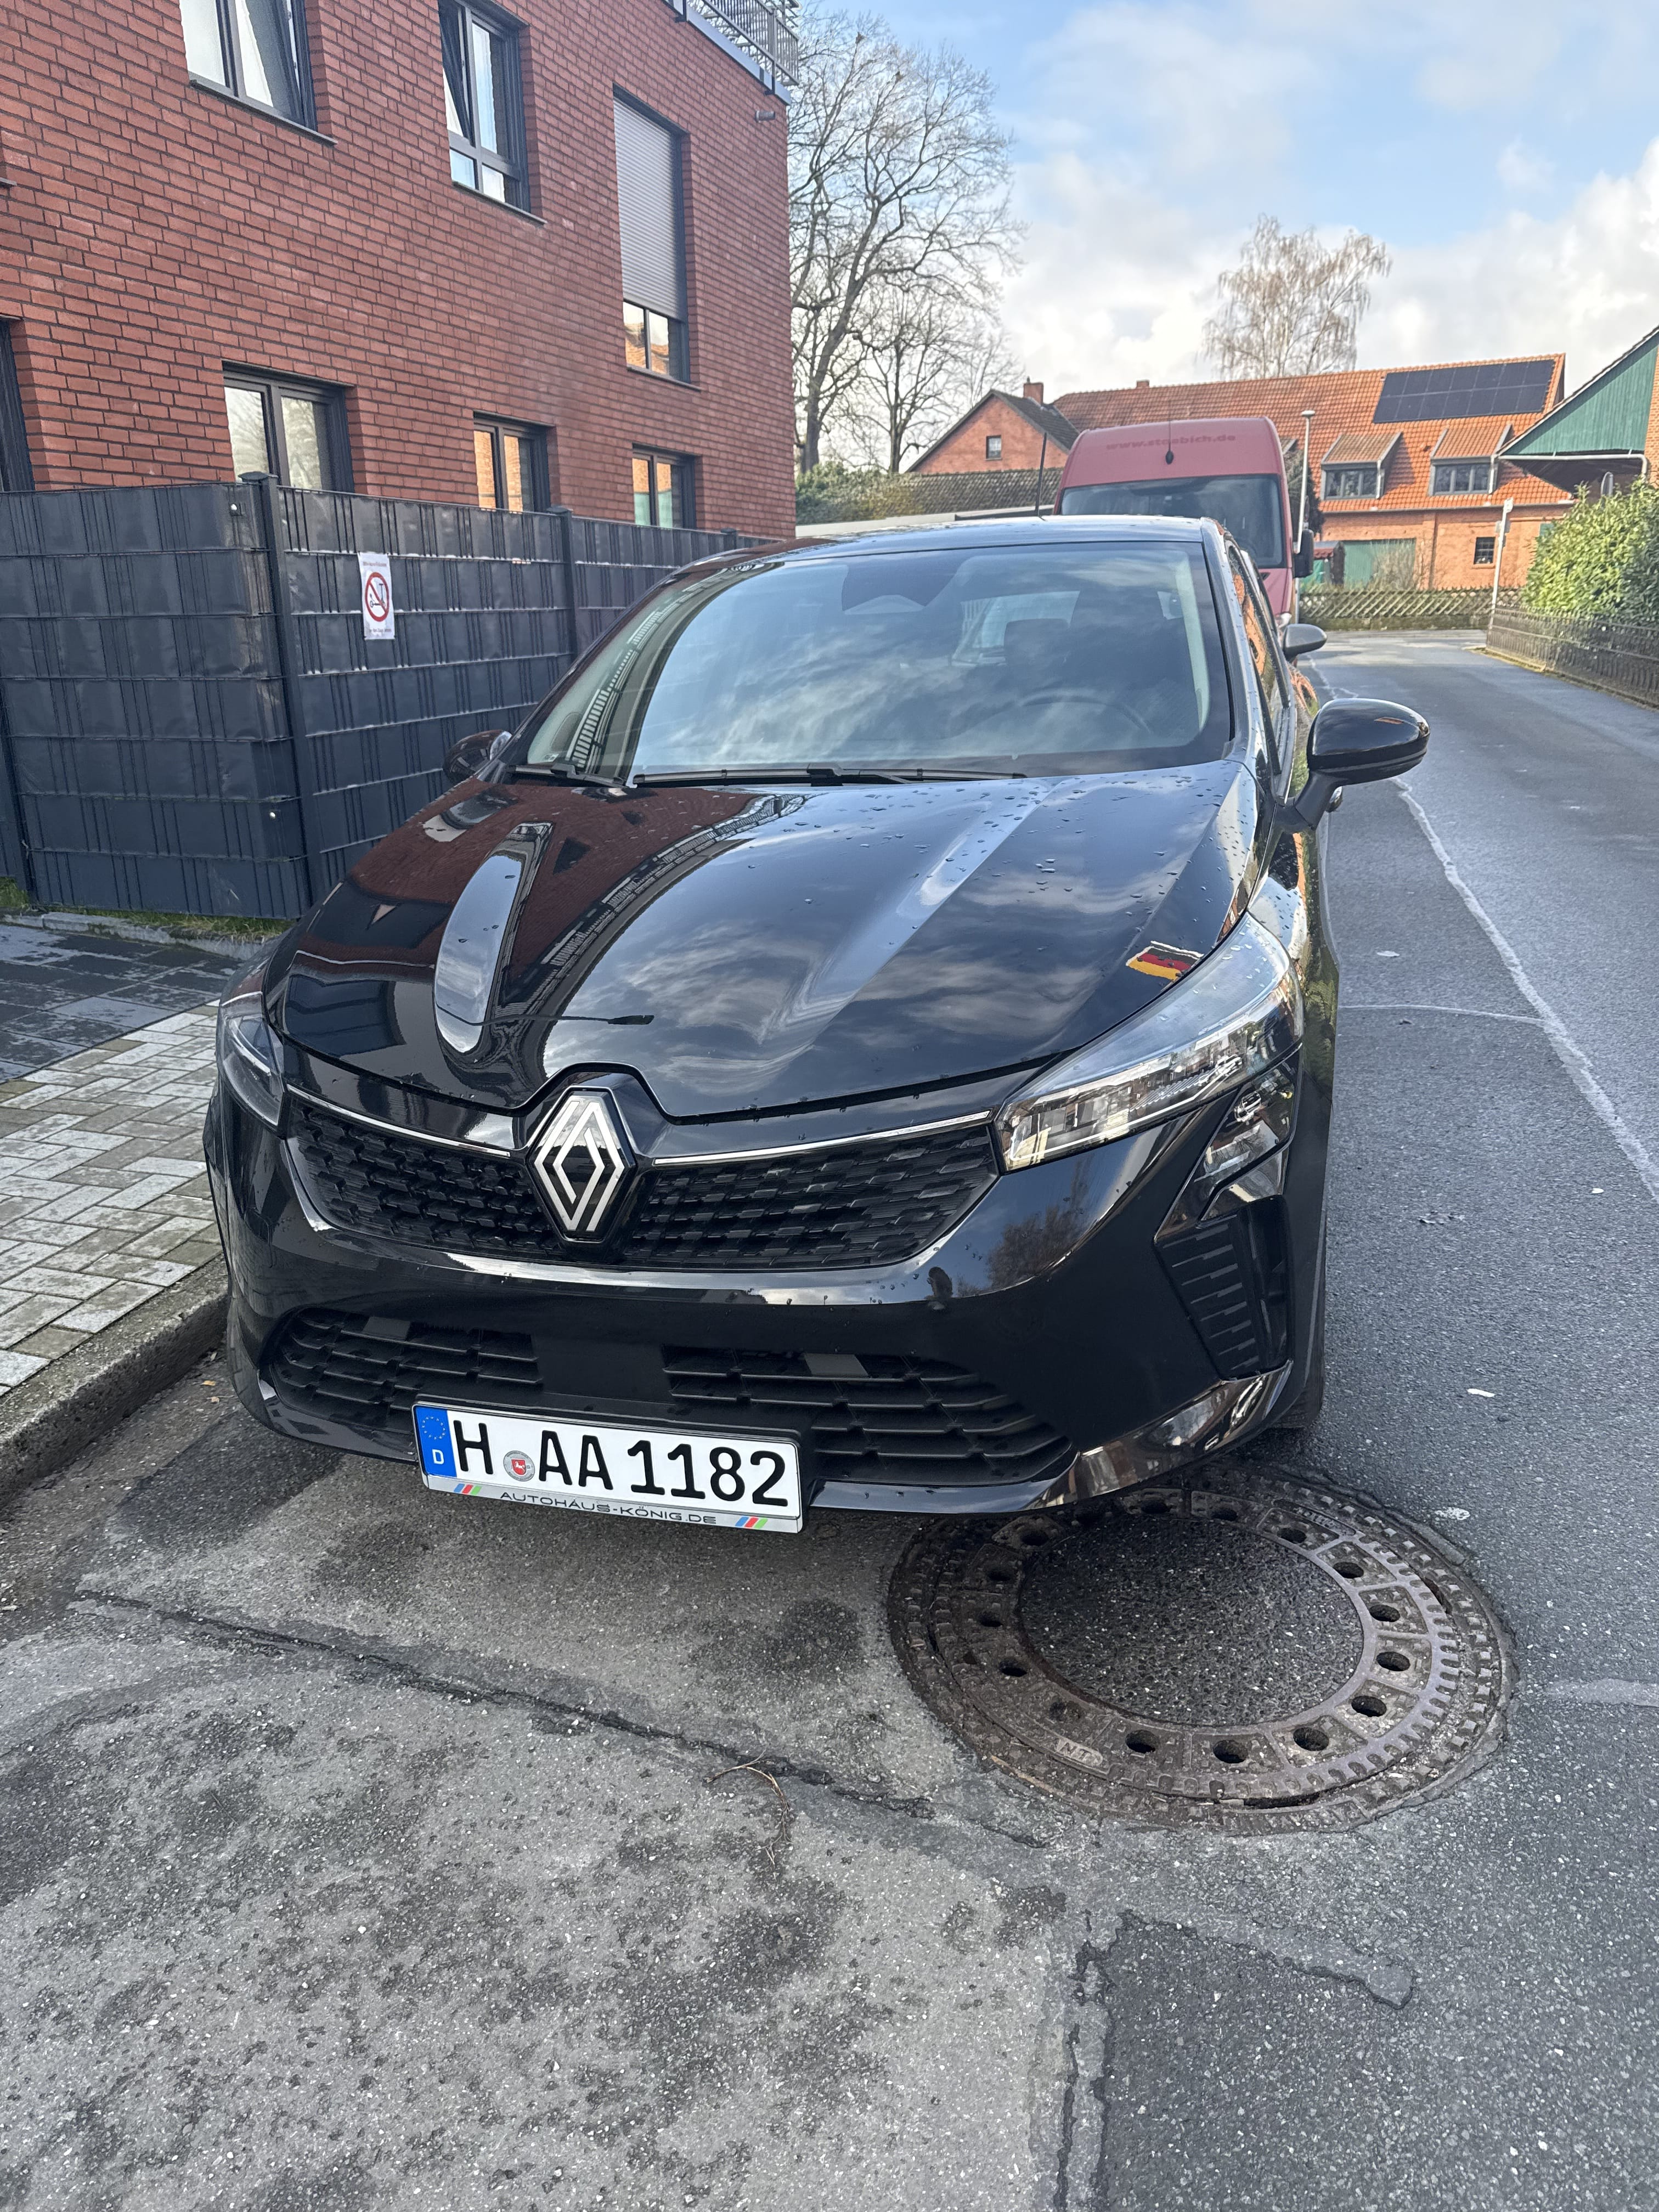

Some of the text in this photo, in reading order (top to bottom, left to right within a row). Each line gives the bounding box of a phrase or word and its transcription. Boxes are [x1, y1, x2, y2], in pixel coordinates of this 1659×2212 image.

[432, 1448, 444, 1465] D
[453, 1419, 494, 1475] H
[538, 1430, 614, 1491] AA
[627, 1440, 788, 1507] 1182
[500, 1491, 716, 1524] AUTOHAUS-KÖNIG.DE
